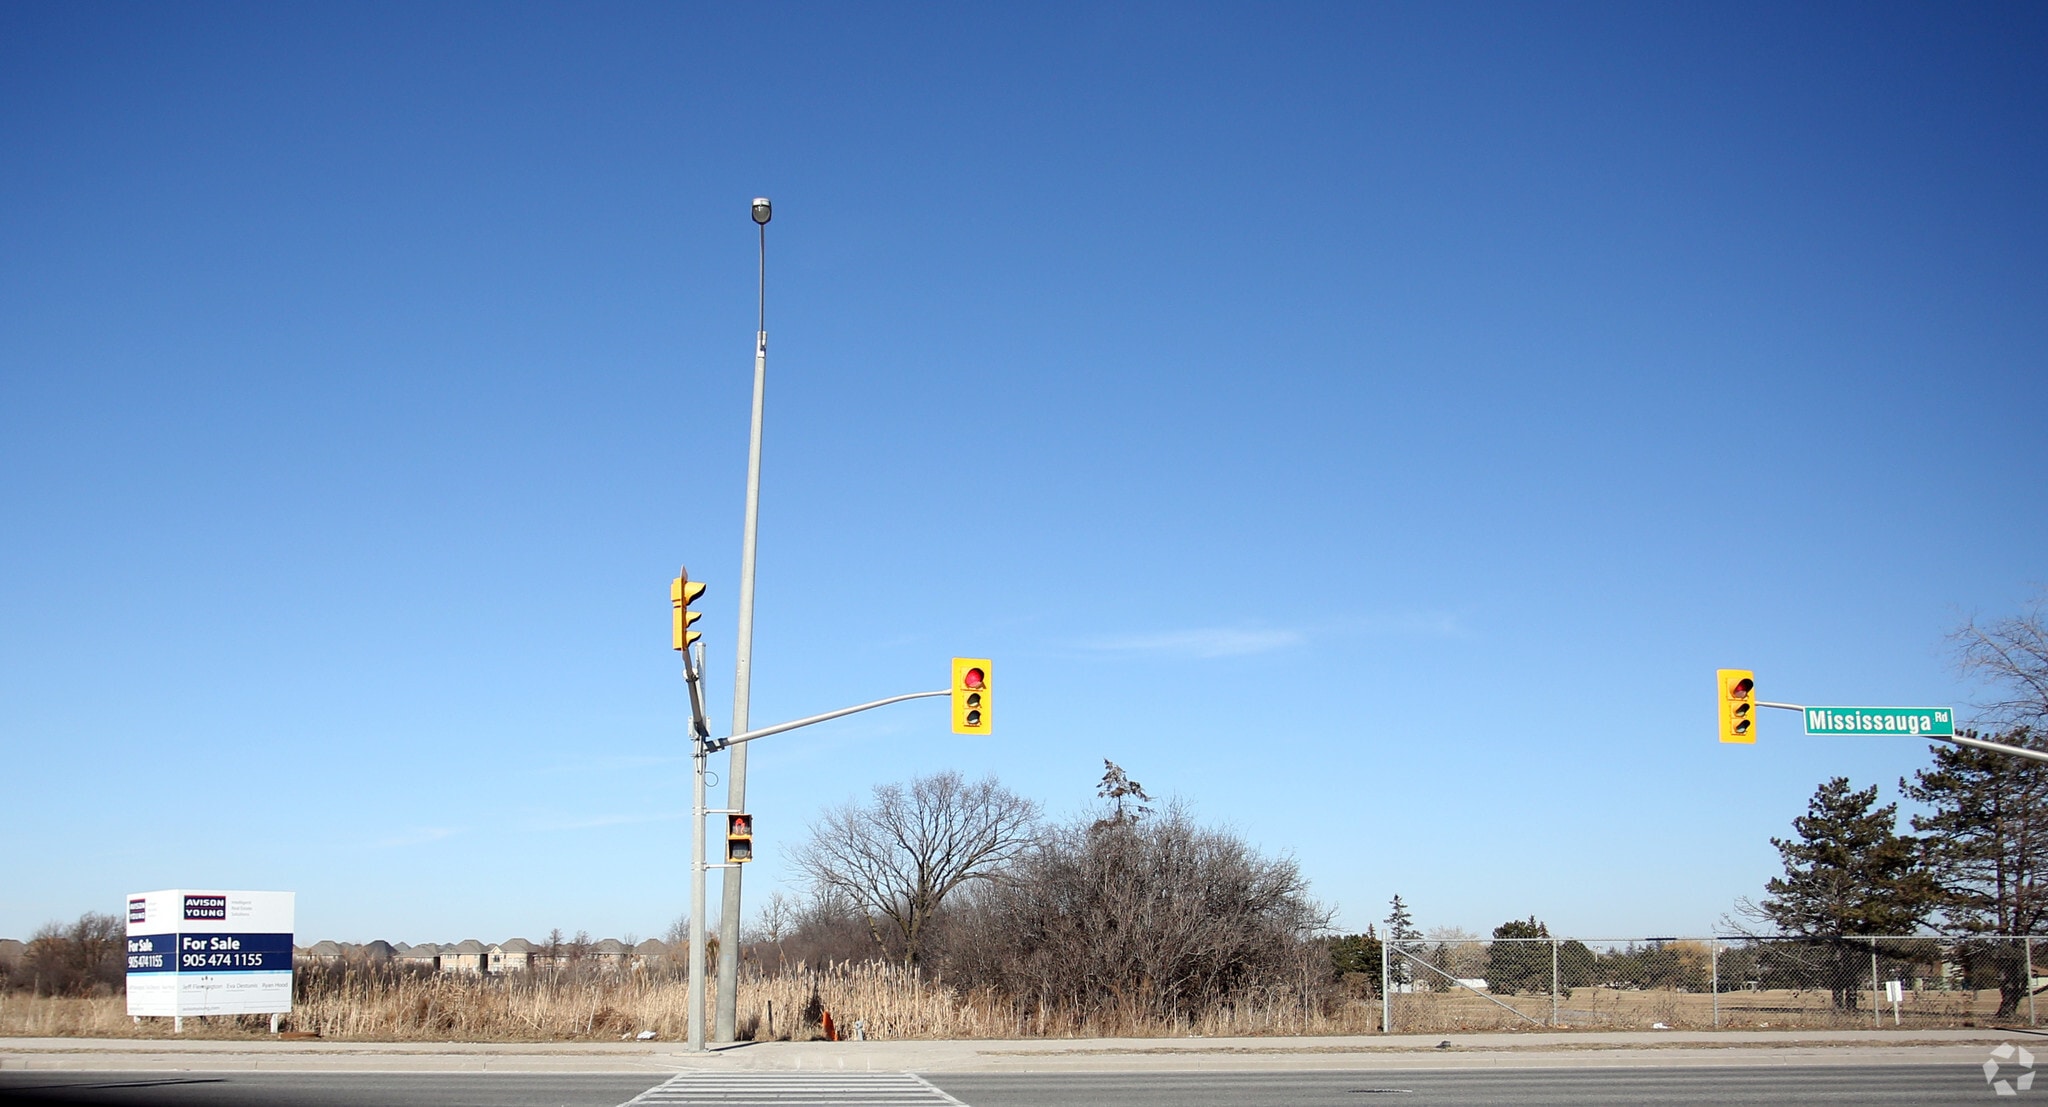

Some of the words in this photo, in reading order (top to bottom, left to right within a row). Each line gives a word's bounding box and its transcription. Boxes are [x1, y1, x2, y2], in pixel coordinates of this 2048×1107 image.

[1808, 710, 1931, 734] Mississauga
[1934, 711, 1948, 723] Rd
[185, 898, 225, 907] AVISON
[185, 908, 225, 917] YOUNG
[128, 939, 139, 952] For
[139, 938, 153, 952] Sale
[183, 937, 207, 950] For
[210, 936, 240, 950] Sale
[149, 954, 163, 968] 1155
[183, 953, 206, 967] 905
[207, 953, 232, 967] 474
[234, 953, 262, 966] 1155
